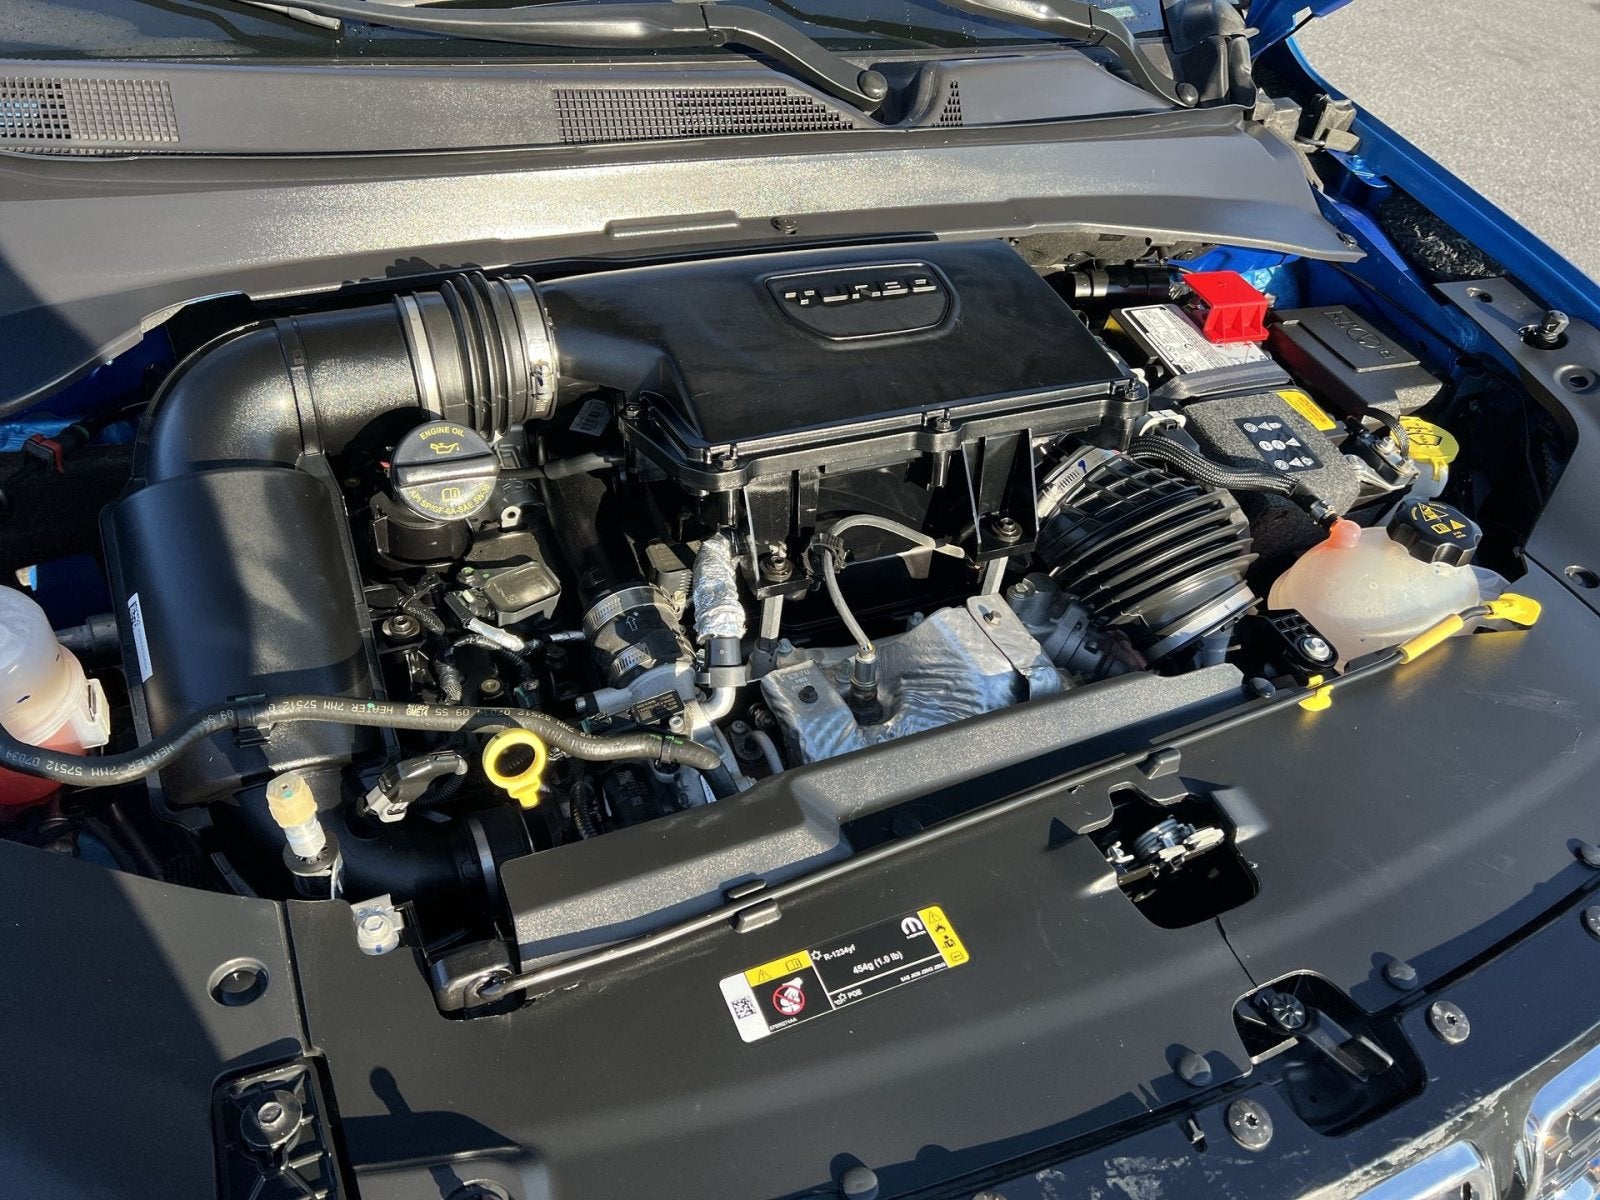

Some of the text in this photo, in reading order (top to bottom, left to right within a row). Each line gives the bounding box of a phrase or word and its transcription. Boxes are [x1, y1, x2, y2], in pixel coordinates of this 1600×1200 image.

[419, 426, 465, 440] ENGINE OIL
[282, 699, 318, 711] 57512
[323, 700, 345, 711] 7MM
[351, 703, 394, 714] HEATER
[219, 708, 234, 721] 09
[435, 708, 449, 717] 55
[455, 708, 470, 717] 09
[126, 742, 176, 772] HEATER
[45, 760, 83, 776] 57512
[90, 764, 119, 777] 7MM
[823, 943, 857, 962] R-1234yf
[852, 949, 904, 976] 454g (1.0 lb)
[846, 988, 863, 1000] POE
